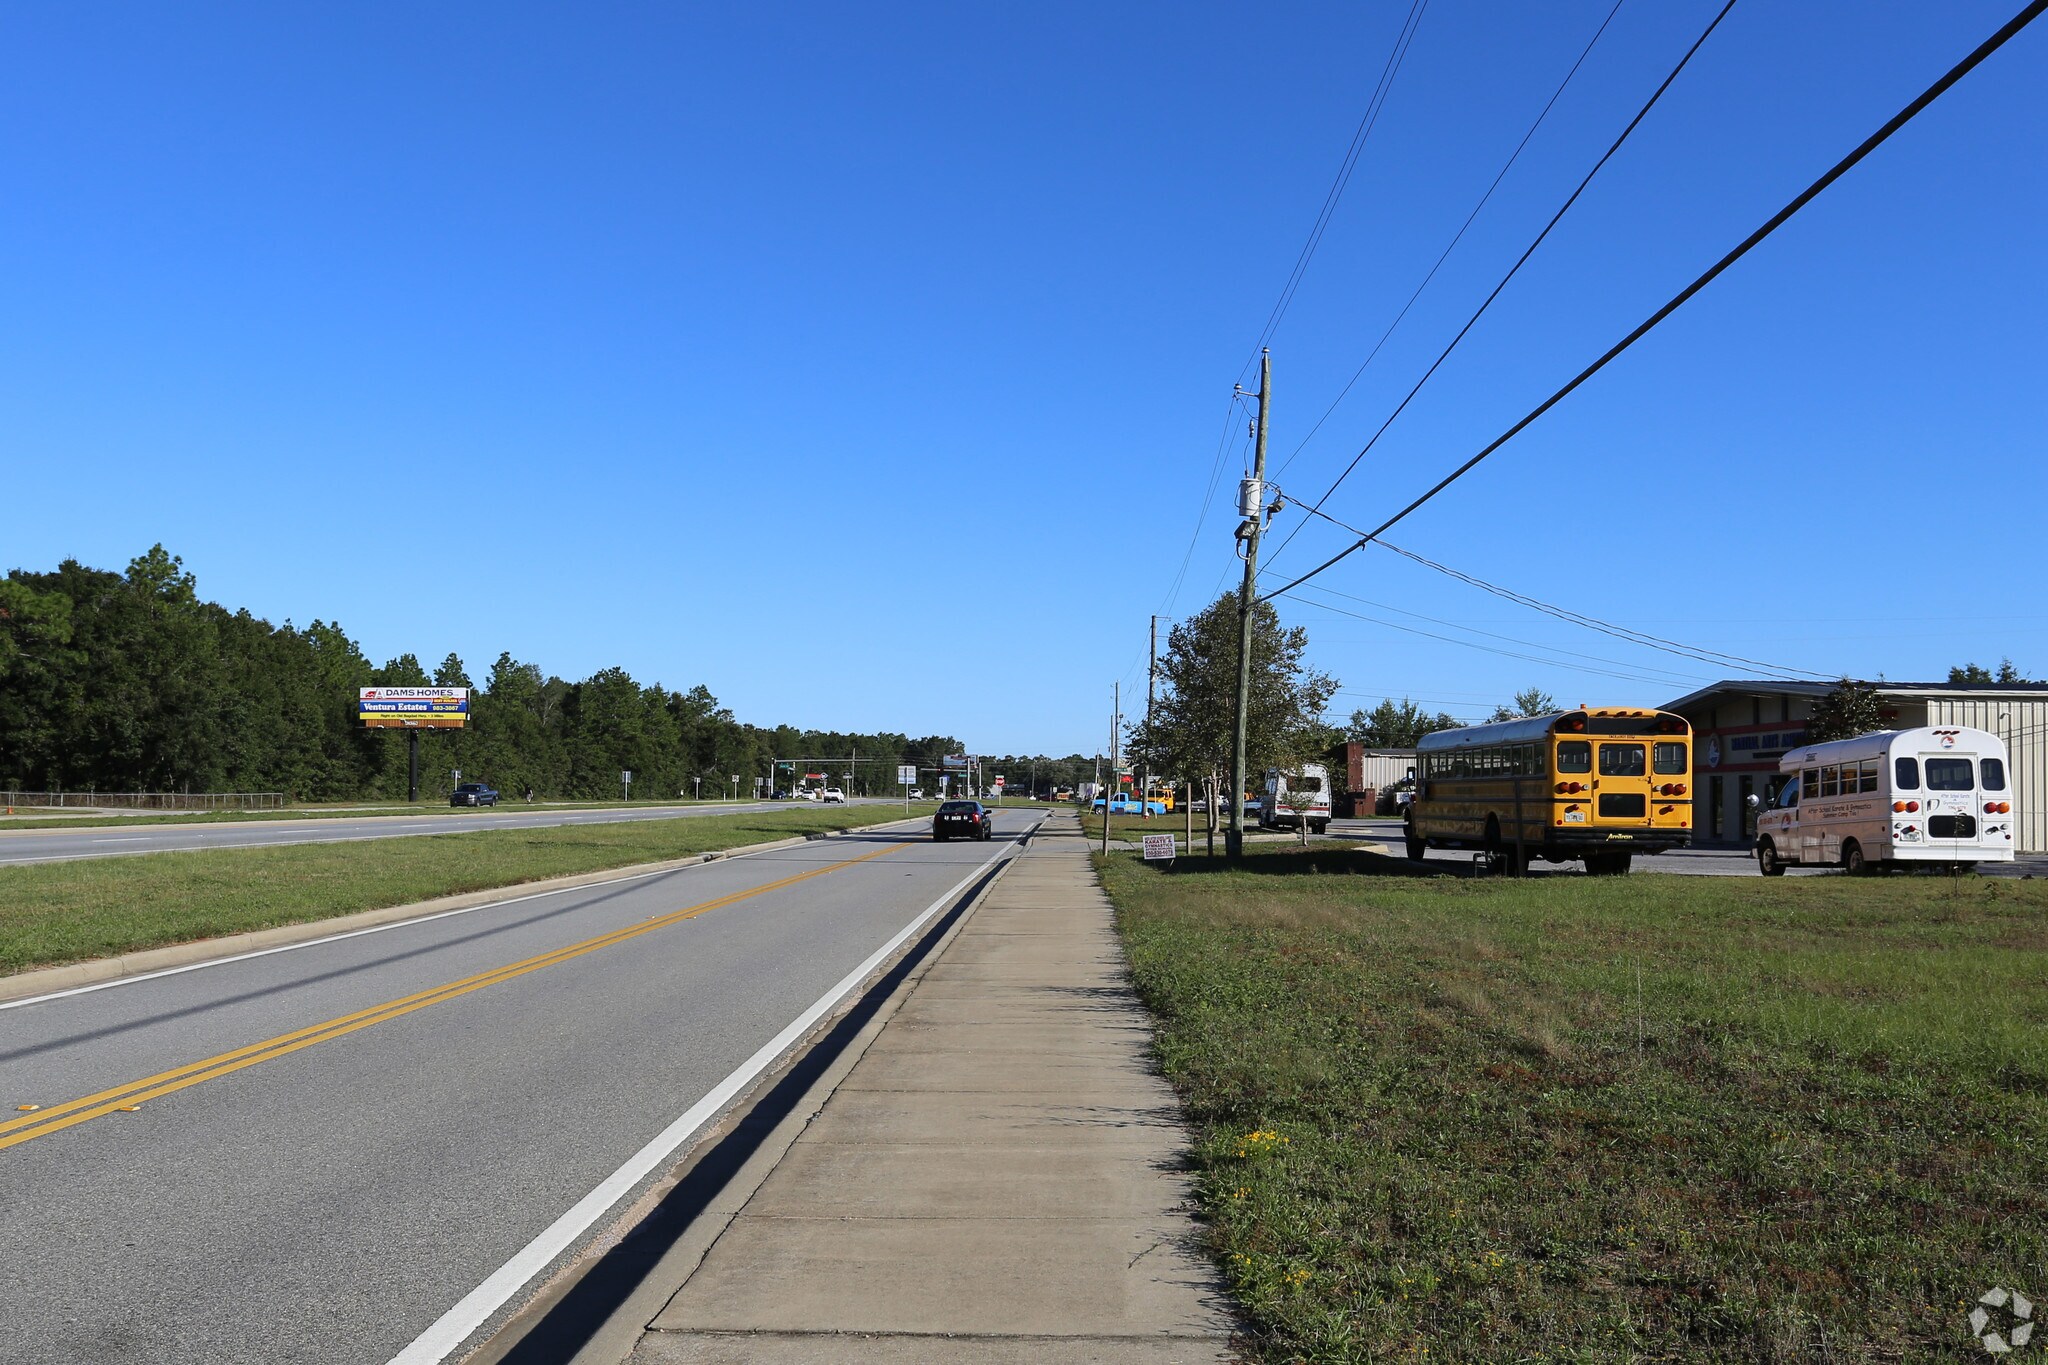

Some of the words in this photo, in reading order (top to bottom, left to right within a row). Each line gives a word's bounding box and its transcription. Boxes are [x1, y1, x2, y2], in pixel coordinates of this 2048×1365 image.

[417, 689, 454, 697] HOMES
[363, 703, 396, 711] Ventura
[398, 703, 428, 711] Estates
